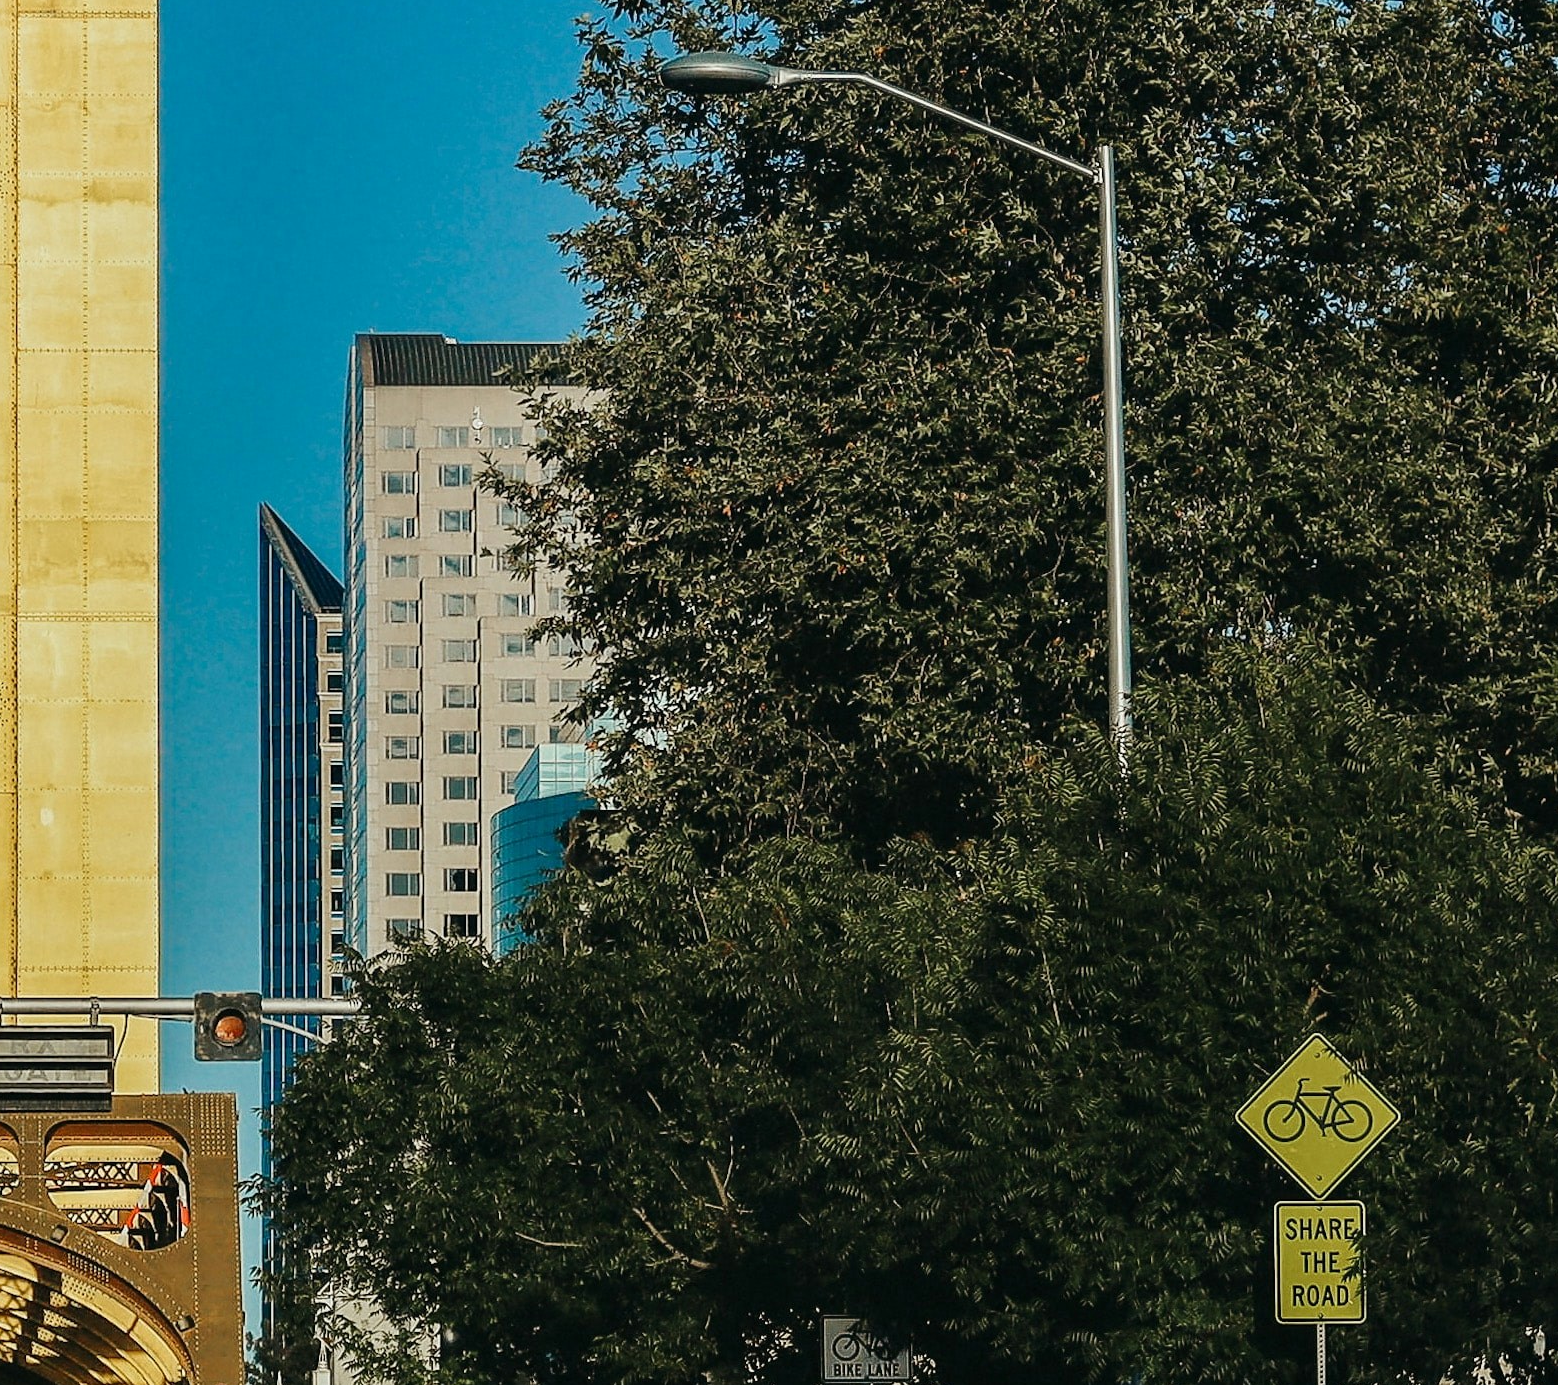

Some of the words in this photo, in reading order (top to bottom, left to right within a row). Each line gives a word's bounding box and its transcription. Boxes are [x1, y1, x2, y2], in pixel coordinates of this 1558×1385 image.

[1285, 1218, 1354, 1240] SHARE
[1300, 1252, 1340, 1273] THE
[1292, 1285, 1349, 1306] ROAD
[834, 1364, 862, 1376] BIKE
[868, 1364, 900, 1376] LANE
